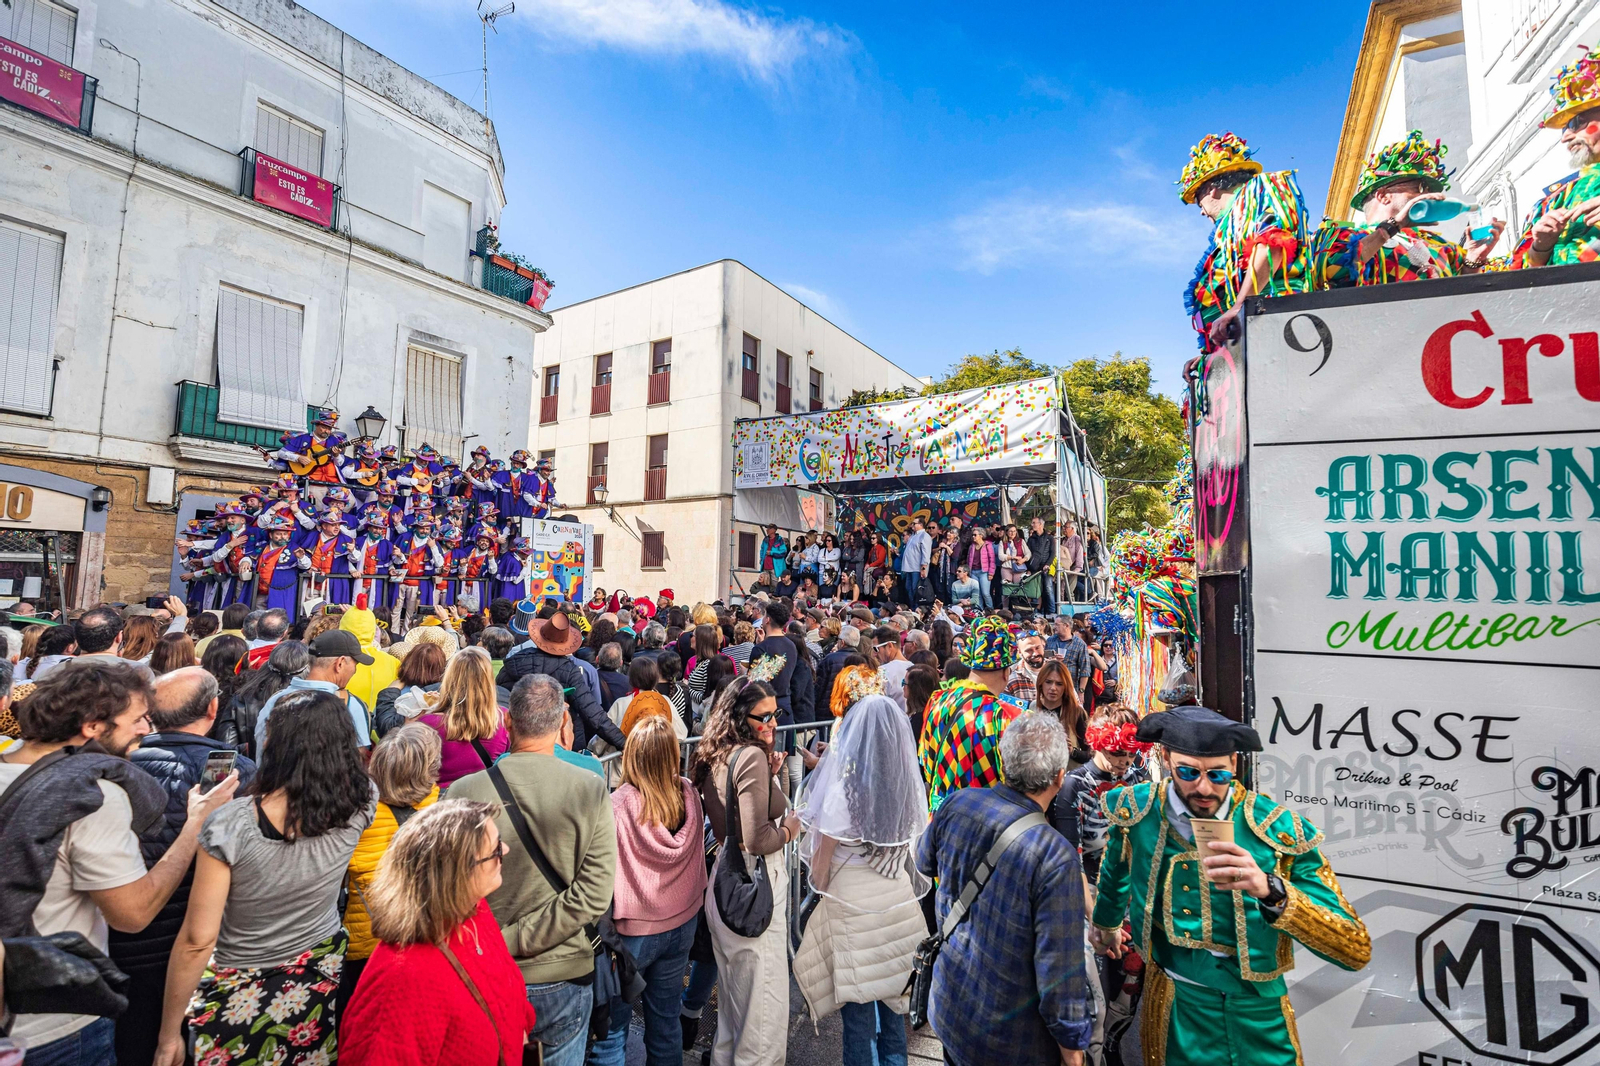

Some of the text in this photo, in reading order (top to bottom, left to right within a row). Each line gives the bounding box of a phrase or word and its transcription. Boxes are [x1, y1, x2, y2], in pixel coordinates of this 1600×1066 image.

[0, 59, 38, 84] STO ES
[257, 156, 307, 182] Cruzcampo
[278, 178, 306, 196] ESTO ES
[1283, 313, 1333, 377] 9
[799, 438, 830, 481] CON
[0, 483, 34, 521] O
[1315, 446, 1600, 523] ARSEN
[1325, 530, 1600, 606] MANIL
[1326, 610, 1600, 651] Multibar
[1269, 696, 1520, 763] MASSE
[1335, 767, 1458, 792] Drikns & Pool
[1531, 765, 1600, 818] M
[1284, 790, 1328, 806] Paseo
[1406, 803, 1416, 815] 5
[1437, 806, 1486, 823] Cádiz
[1297, 790, 1485, 869] EBAR
[1337, 846, 1371, 859] Brunch
[1377, 842, 1409, 852] Drinks
[1542, 885, 1583, 900] Plaza
[1433, 918, 1589, 1053] MG
